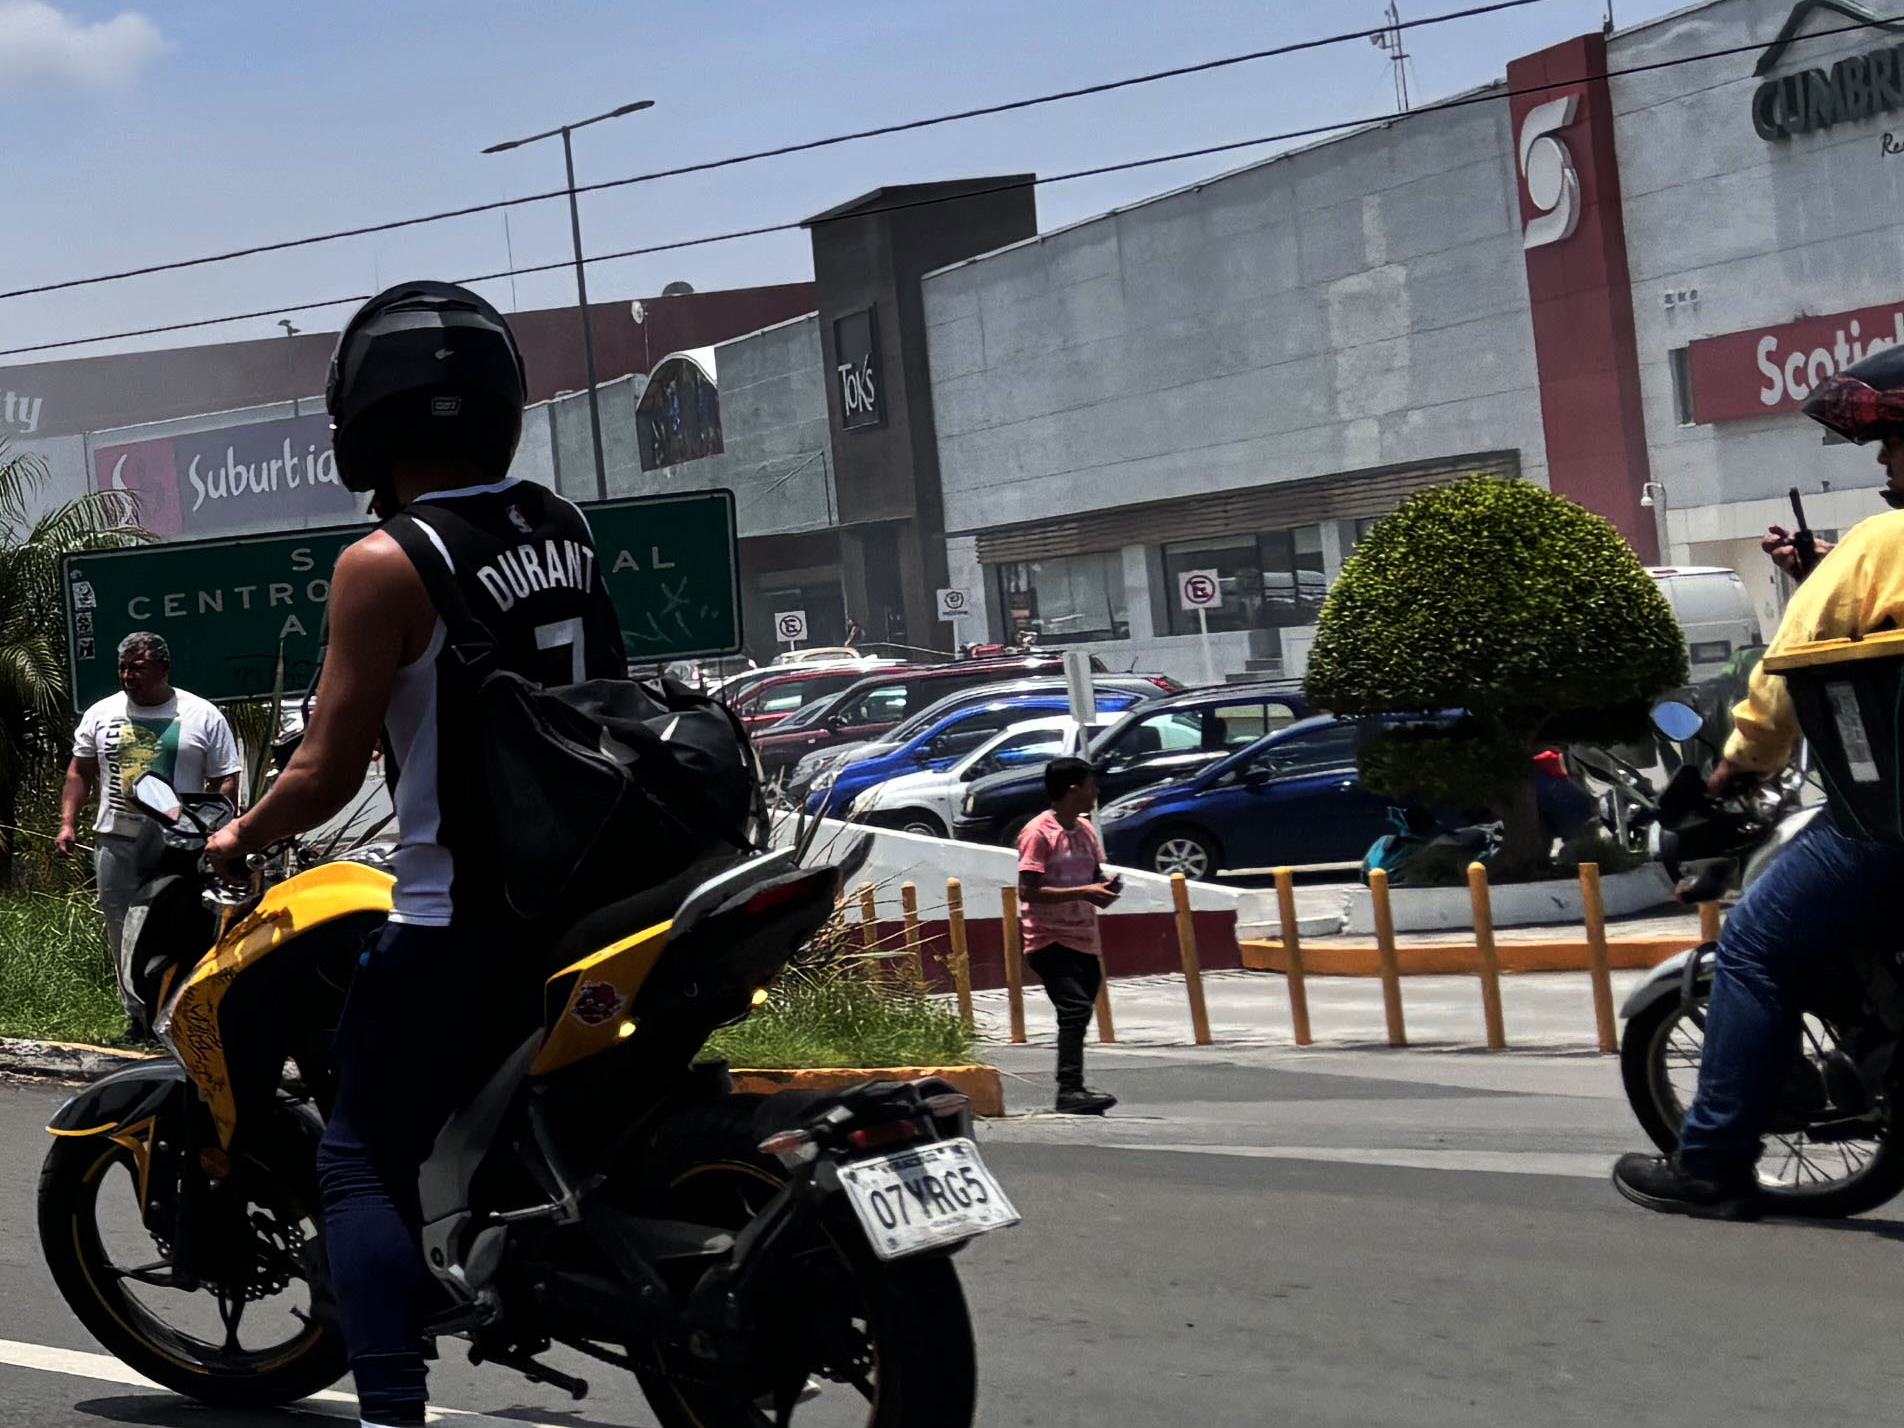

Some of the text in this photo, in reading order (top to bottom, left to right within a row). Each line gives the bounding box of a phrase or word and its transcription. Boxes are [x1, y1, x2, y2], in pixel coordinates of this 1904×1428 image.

[1752, 42, 1904, 142] CUMBR
[1757, 312, 1904, 406] Scoti
[189, 437, 339, 512] Suburbia
[127, 578, 331, 620] CENTRO
[476, 539, 595, 612] DURANT
[534, 616, 587, 684] 7
[870, 1166, 989, 1230] 07YRG5
